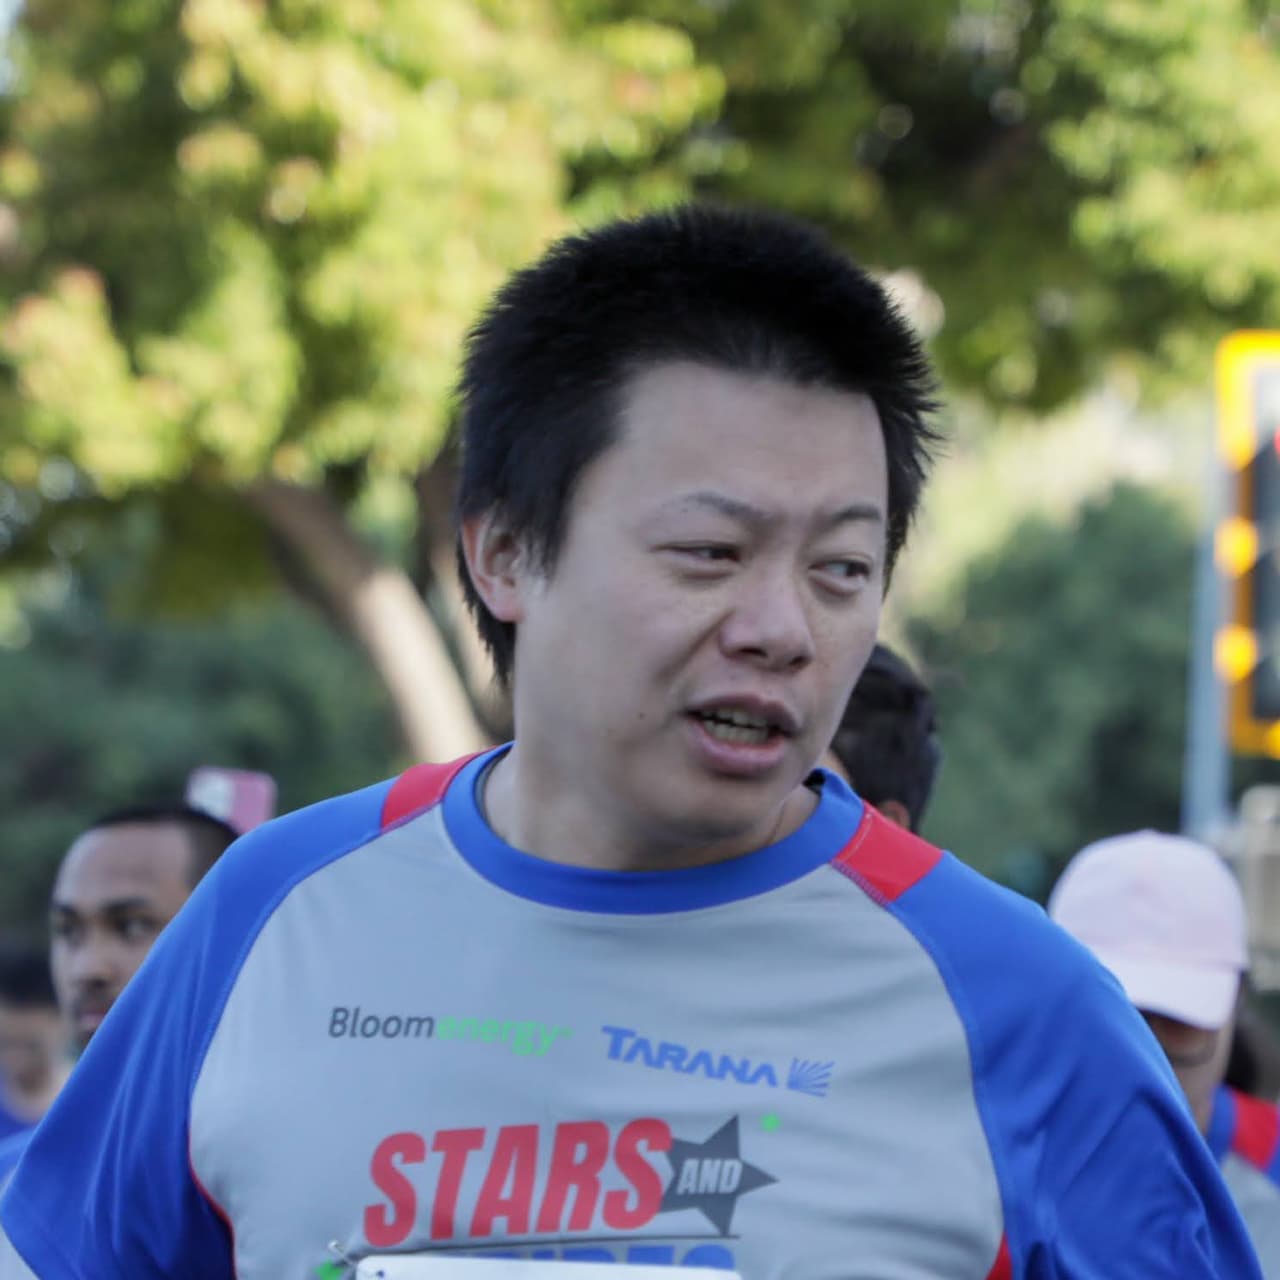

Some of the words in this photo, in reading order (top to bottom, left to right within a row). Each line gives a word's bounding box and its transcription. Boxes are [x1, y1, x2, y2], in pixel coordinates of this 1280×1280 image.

[601, 1025, 778, 1088] TARANA
[363, 1117, 673, 1248] STARS
[677, 1158, 743, 1195] AND
